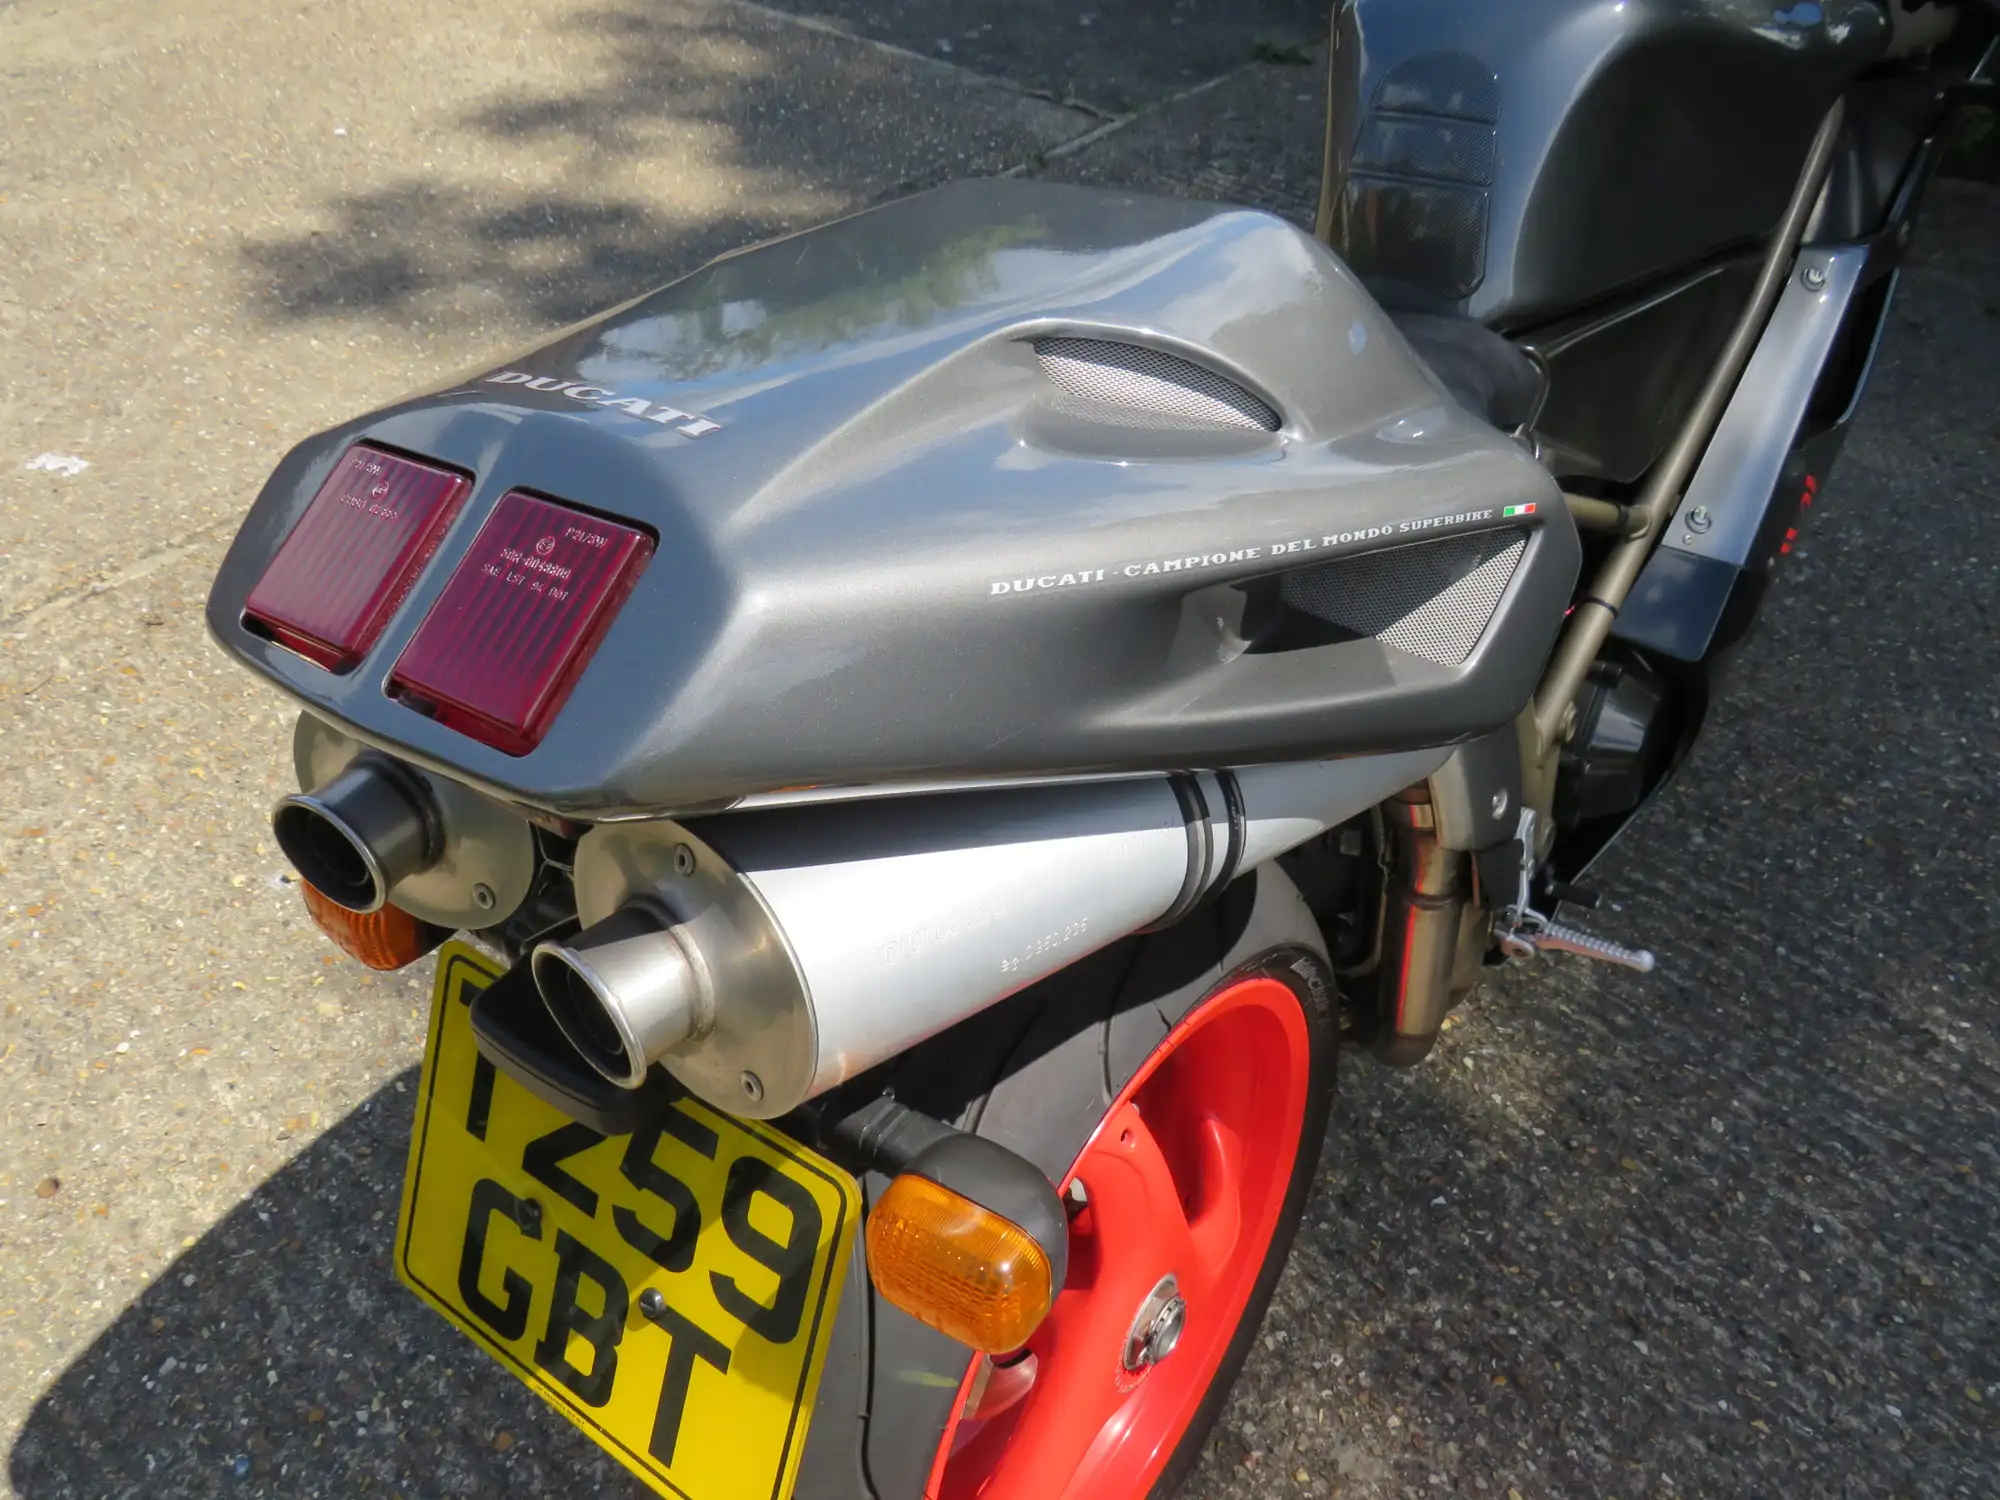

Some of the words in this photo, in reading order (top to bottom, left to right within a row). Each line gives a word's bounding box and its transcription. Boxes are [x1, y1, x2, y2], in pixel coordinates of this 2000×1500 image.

[486, 372, 721, 436] DUCATI
[990, 569, 1104, 595] DUCATI
[1123, 547, 1261, 577] CAMPIONE
[1270, 538, 1317, 556] DEL
[1321, 525, 1393, 547] MONDO
[1399, 509, 1493, 533] SUPERBIKE
[458, 1177, 733, 1470] GBT
